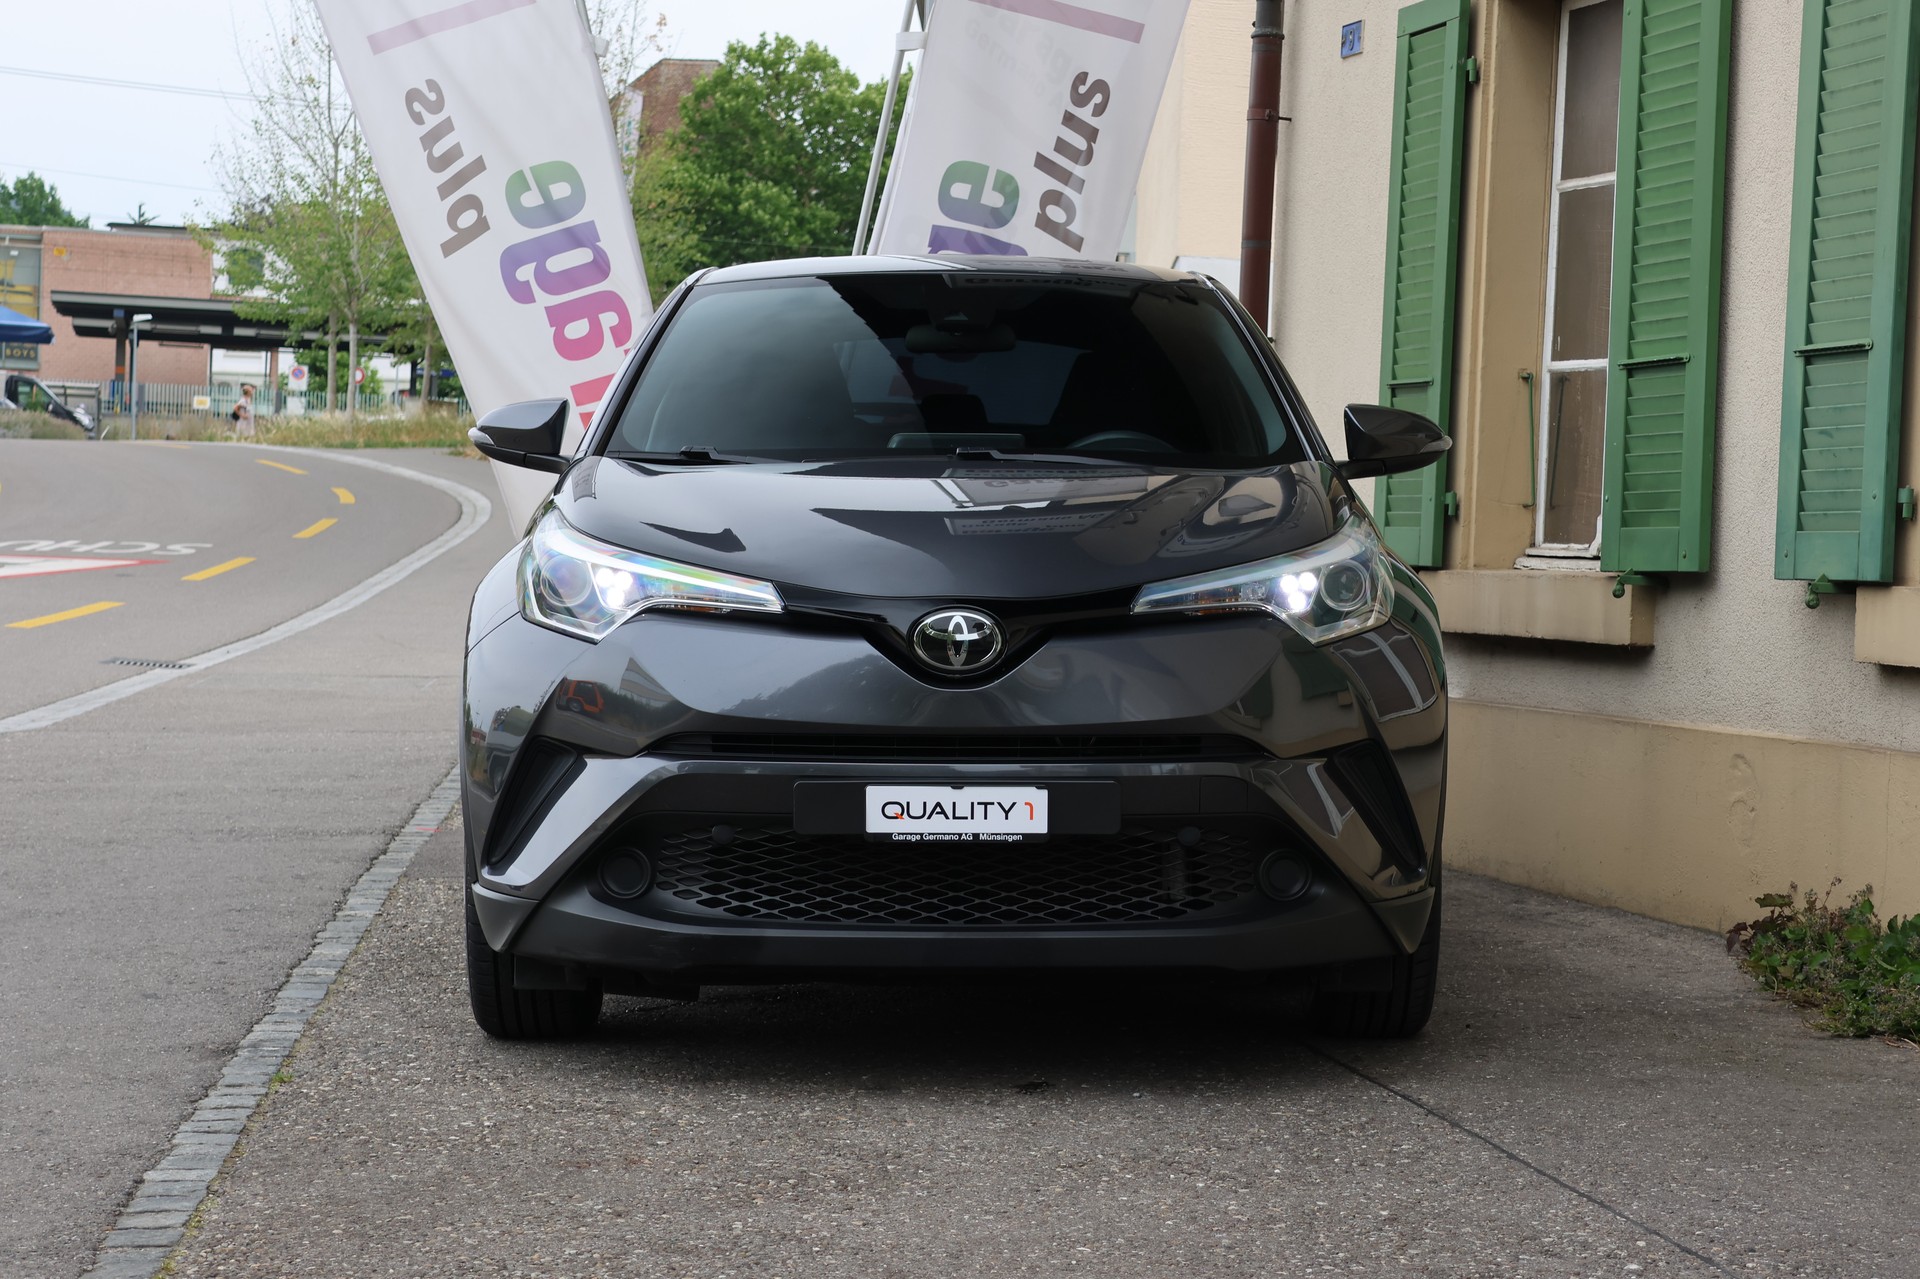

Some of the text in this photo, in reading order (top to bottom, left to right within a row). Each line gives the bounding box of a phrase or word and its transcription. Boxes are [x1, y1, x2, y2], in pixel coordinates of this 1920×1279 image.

[1033, 71, 1111, 253] plus
[892, 832, 1023, 841] Garage Germano AG Münsingen
